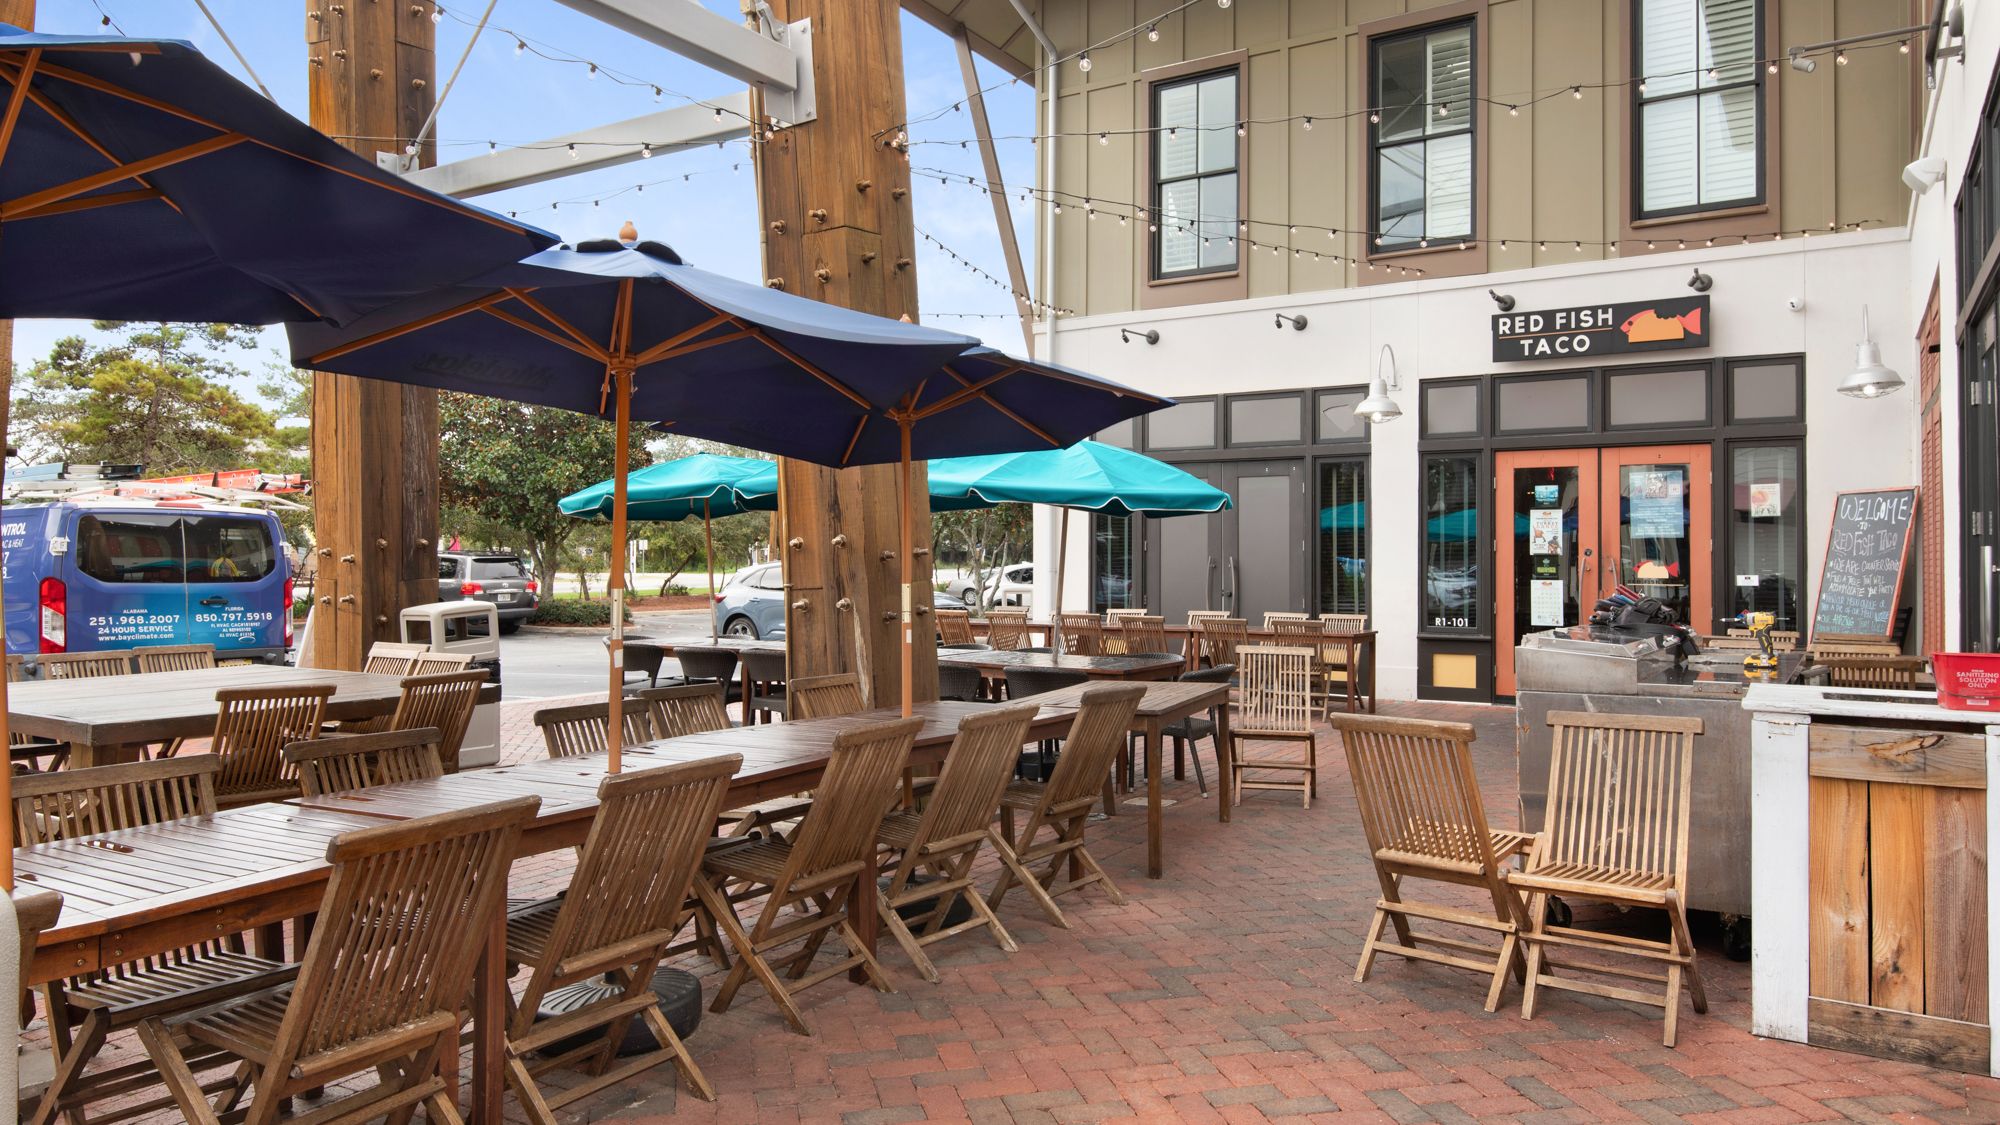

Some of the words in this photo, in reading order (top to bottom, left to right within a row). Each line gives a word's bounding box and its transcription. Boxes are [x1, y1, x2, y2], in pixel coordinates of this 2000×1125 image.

[1498, 314, 1544, 335] RED
[1556, 307, 1613, 330] FISH
[1519, 334, 1591, 356] TACO
[1841, 497, 1909, 524] WELCOME
[1, 523, 26, 536] NTROL
[1860, 522, 1868, 530] TO
[1832, 529, 1854, 552] RED
[1854, 531, 1875, 556] FISH
[1877, 530, 1898, 551] TACO
[1833, 559, 1845, 572] WE
[1845, 559, 1860, 575] ARE
[89, 615, 180, 626] 251.968.2007
[195, 612, 273, 622] 850.797.5918
[1435, 617, 1468, 627] R1-101
[98, 627, 110, 635] 24
[138, 625, 173, 633] SERVICE
[98, 633, 175, 642] www.bayclimate.com
